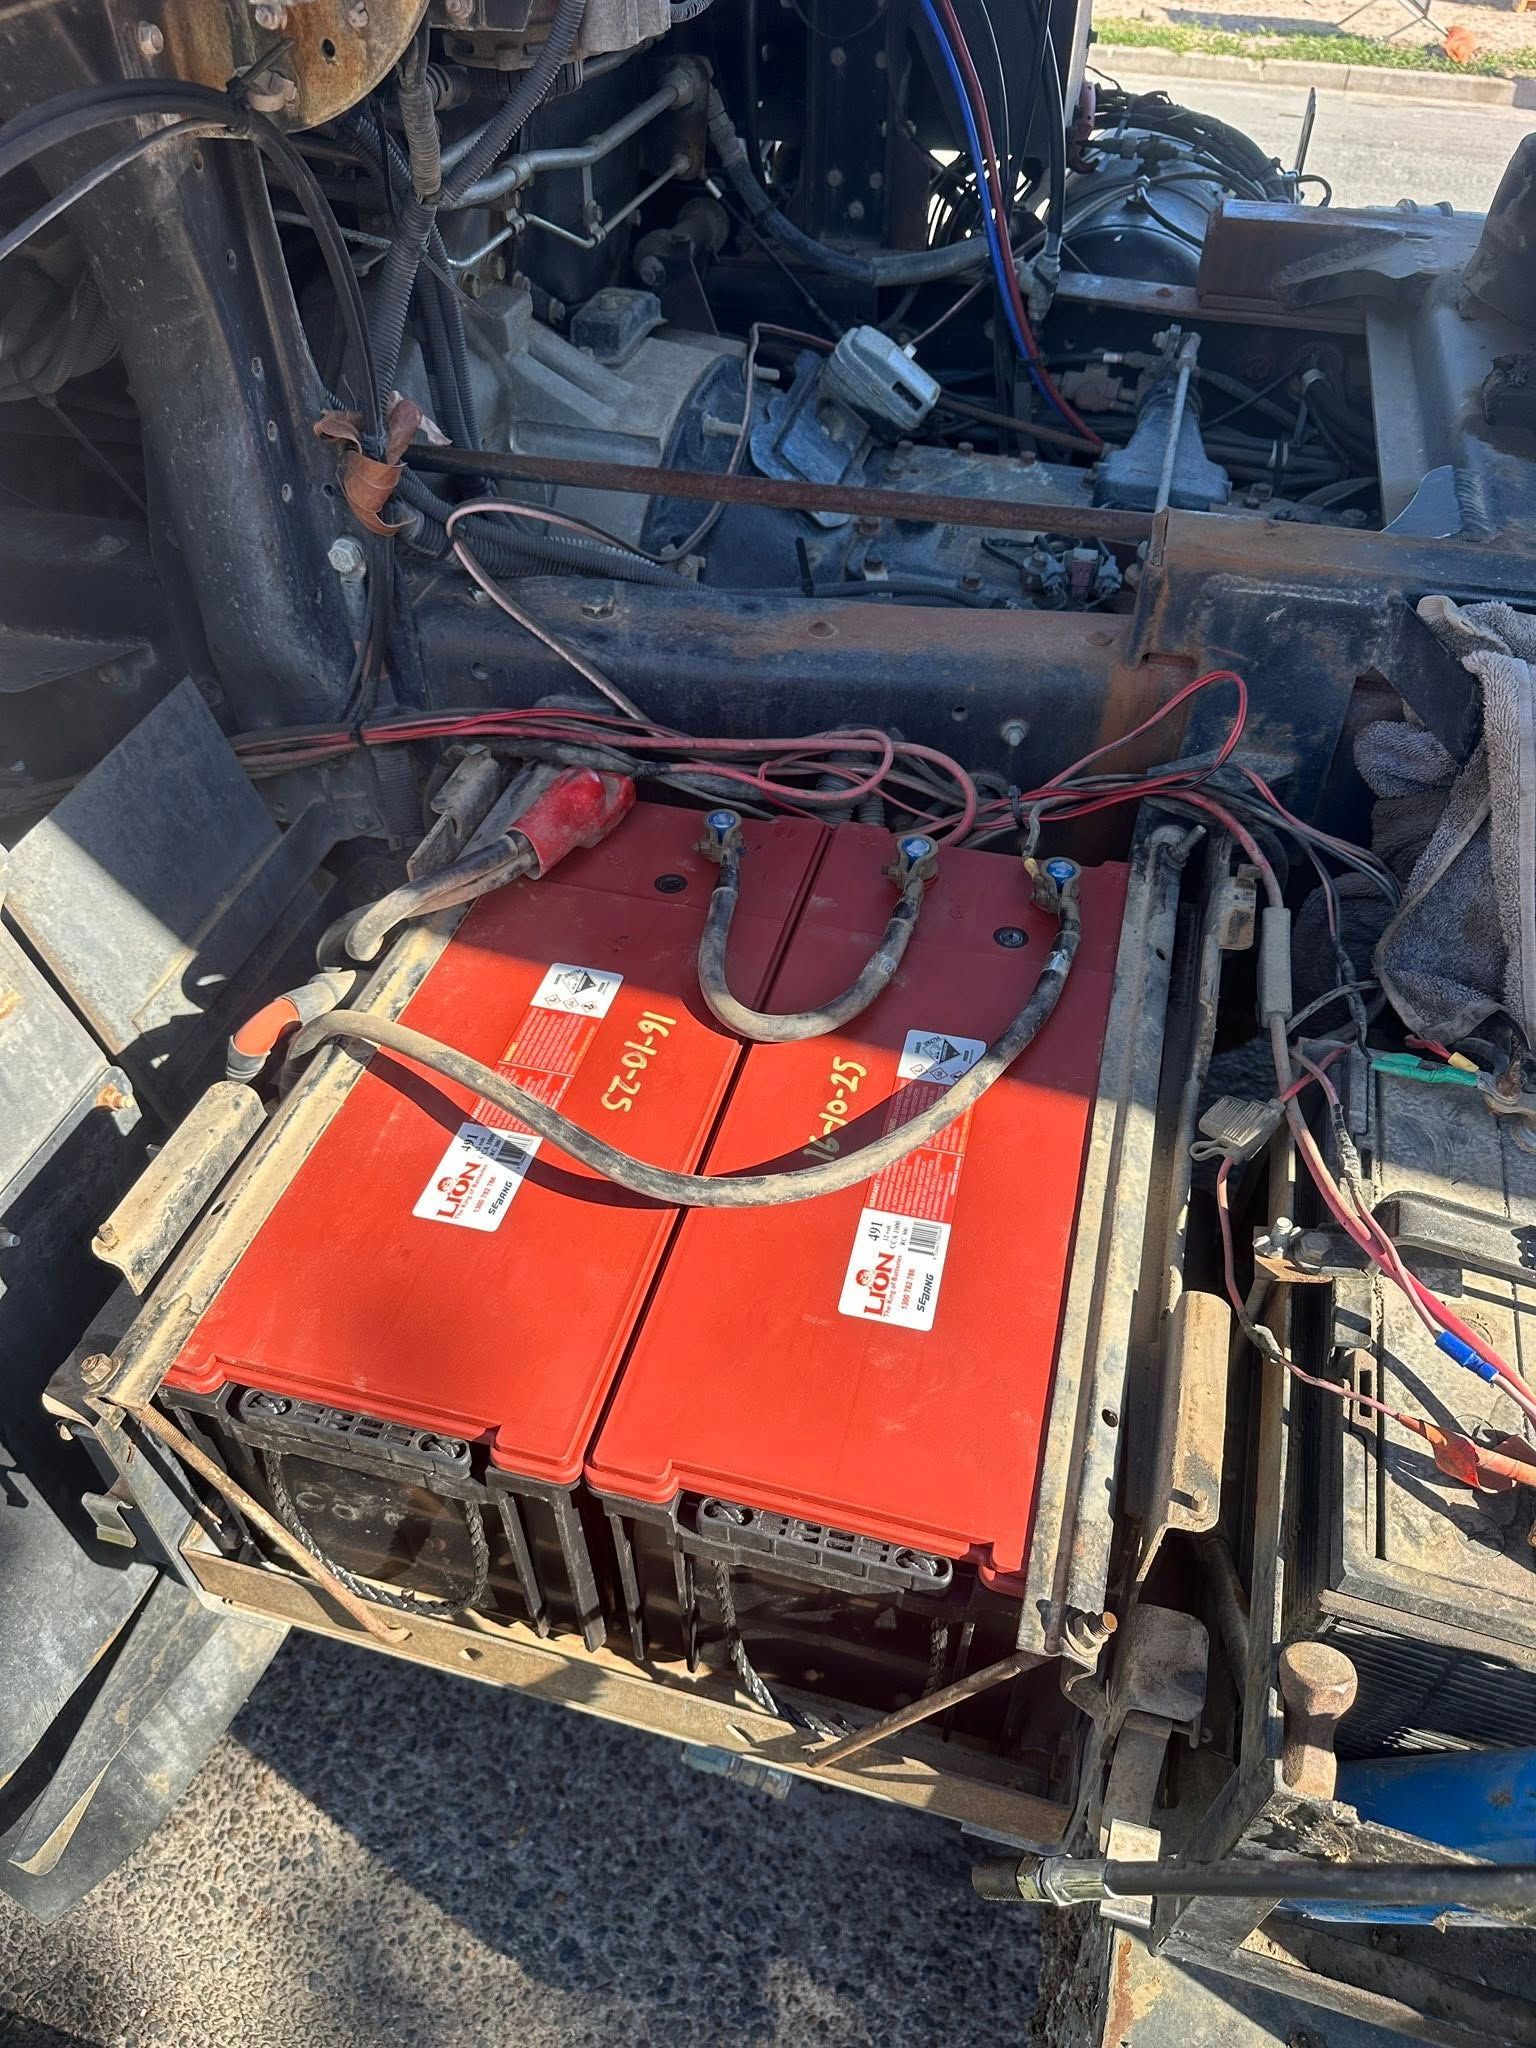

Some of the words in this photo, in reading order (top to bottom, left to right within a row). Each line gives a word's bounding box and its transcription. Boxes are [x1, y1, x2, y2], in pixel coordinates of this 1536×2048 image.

[601, 1011, 677, 1112] 16-10-25
[803, 1056, 867, 1160] 16-10-25
[461, 1134, 479, 1152] 491
[436, 1162, 482, 1218] LION
[488, 1180, 513, 1216] SEBANG
[868, 1221, 883, 1241] 491
[889, 1235, 899, 1249] CCA
[900, 1236, 907, 1246] RC
[891, 1255, 902, 1281] Batteries
[863, 1252, 895, 1316] LION
[917, 1273, 935, 1313] SEBANG
[887, 1289, 897, 1306] King
[901, 1292, 911, 1309] 1300
[883, 1306, 891, 1318] The
